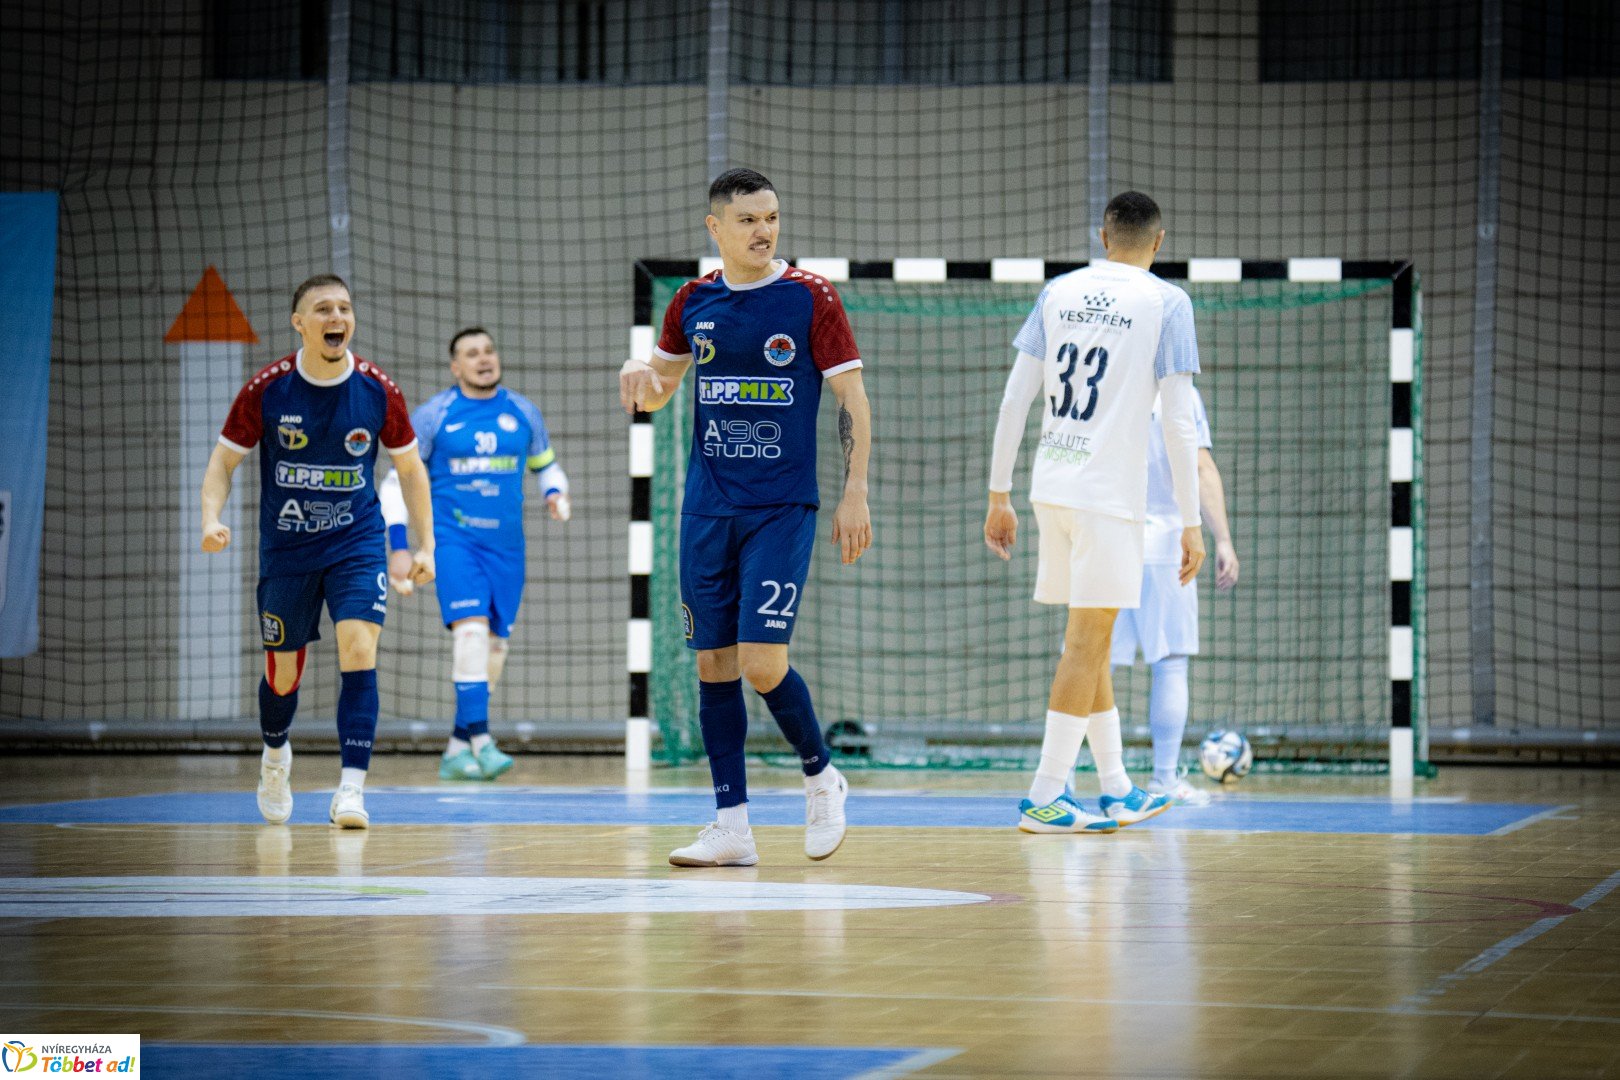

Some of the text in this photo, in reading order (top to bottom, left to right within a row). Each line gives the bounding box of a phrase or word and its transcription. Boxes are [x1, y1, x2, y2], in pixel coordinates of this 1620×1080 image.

[695, 321, 715, 330] JAKO
[1059, 309, 1133, 329] VESZPRÉM
[1050, 342, 1109, 422] 33
[279, 414, 303, 424] JAKO
[474, 431, 497, 454] 30
[702, 443, 781, 459] STUDIO
[277, 513, 354, 533] STUDIO
[377, 572, 387, 601] 9
[757, 580, 798, 617] 22
[764, 619, 787, 630] JAKO
[345, 738, 371, 748] JAKO
